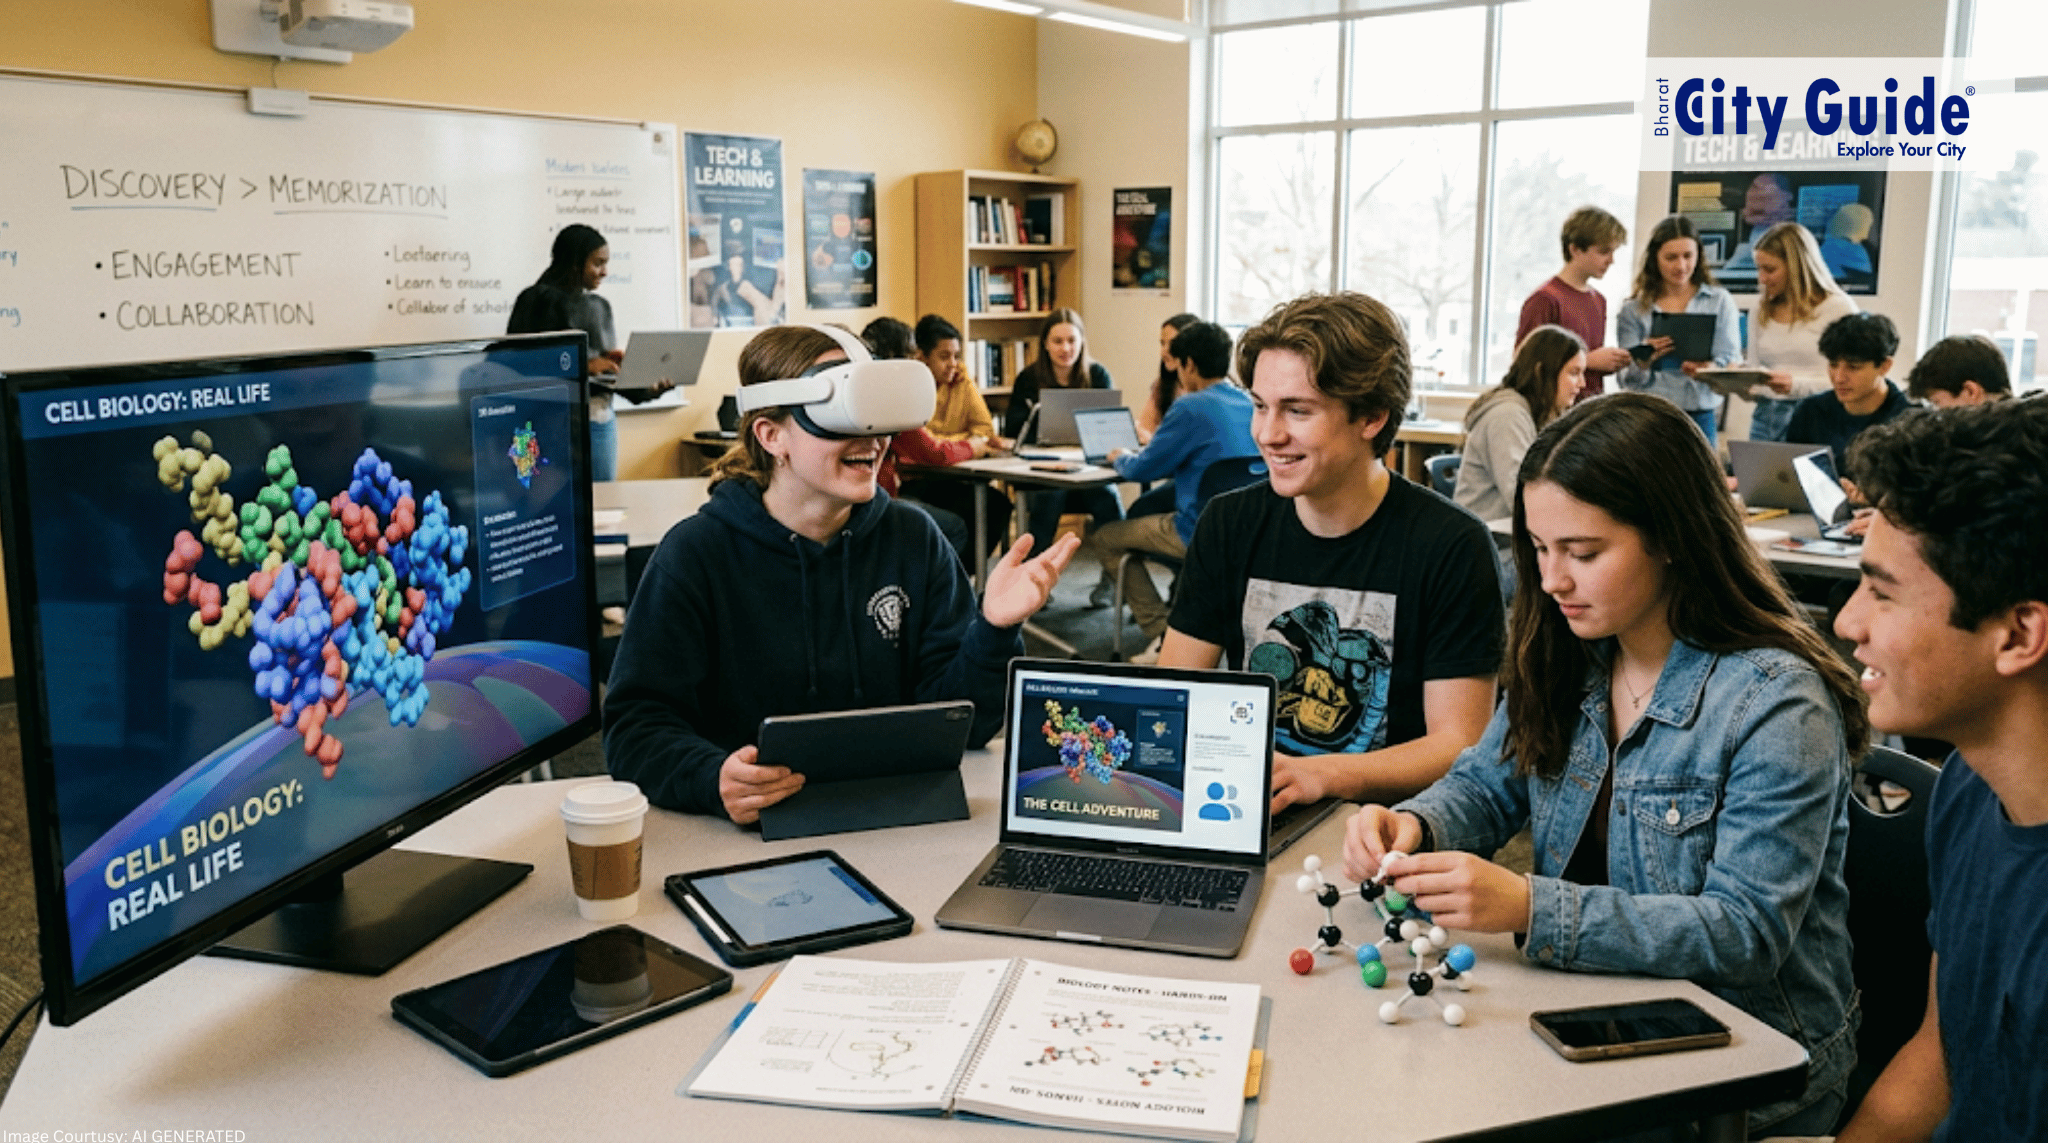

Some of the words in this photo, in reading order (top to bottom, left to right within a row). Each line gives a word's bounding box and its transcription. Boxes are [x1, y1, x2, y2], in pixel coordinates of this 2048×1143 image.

[706, 145, 747, 166] TECH
[750, 148, 763, 167] &
[1683, 135, 1738, 164] TECH
[1743, 133, 1760, 162] &
[59, 164, 226, 206] DISCOVERY
[268, 174, 448, 210] MEMORIZATION
[695, 166, 775, 189] LEARNING
[112, 249, 302, 280] ENGAGEMENT
[116, 300, 315, 331] COLLABORATION
[45, 400, 96, 424] CELL
[98, 391, 188, 419] BIOLOGY:
[191, 386, 235, 409] REAL
[237, 383, 271, 403] LIFE
[1023, 797, 1047, 810] THE
[1050, 799, 1079, 814] CELL
[1081, 803, 1160, 820] ADVENTURE
[104, 837, 176, 890] CELL
[181, 778, 304, 857] BIOLOGY:
[107, 873, 184, 932] REAL
[189, 840, 244, 892] LIFE
